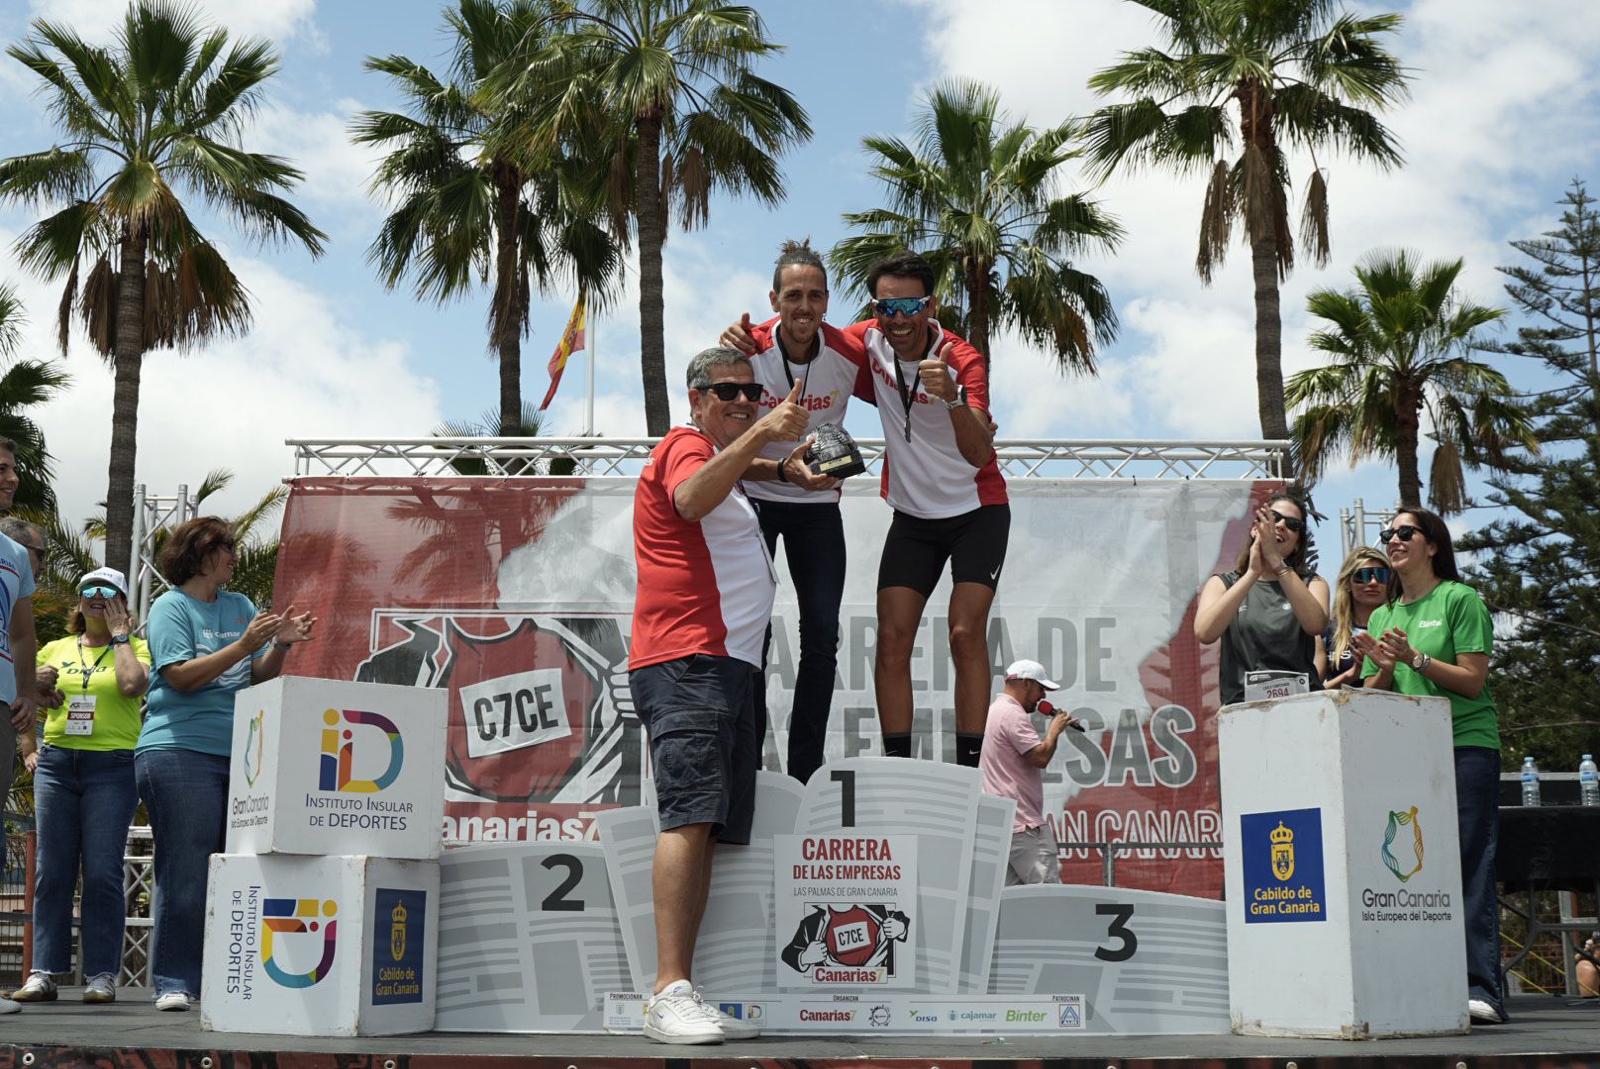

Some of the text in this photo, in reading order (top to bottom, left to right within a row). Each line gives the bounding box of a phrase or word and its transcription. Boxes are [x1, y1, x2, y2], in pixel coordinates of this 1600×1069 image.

[1037, 617, 1117, 692] DE
[474, 684, 559, 741] C7CE
[306, 793, 413, 812] INSTITUTO INSULAR
[831, 770, 855, 827] 1
[310, 813, 407, 830] DE DEPORTES
[443, 810, 600, 842] anarias7
[1095, 809, 1224, 859] CANAR
[802, 838, 892, 861] CARRERA
[793, 865, 901, 880] DE LAS EMPRESAS
[540, 854, 584, 911] 2
[793, 887, 898, 897] LAS PALMAS DE GRAN CANARIA
[1255, 885, 1312, 900] Cabildo de
[1251, 900, 1320, 914] Gran Canaria
[1362, 911, 1452, 923] Isla Europea del Deporte
[227, 890, 244, 993] DE DEPORTES
[838, 928, 864, 946] C7CE
[1094, 904, 1138, 962] 3
[243, 886, 261, 1000] INSTITUTO INSULAR
[379, 966, 416, 981] Cabildo de
[376, 982, 419, 995] Gran Canaria
[960, 1010, 997, 1021] cajamar
[1006, 1009, 1047, 1022] Binter
